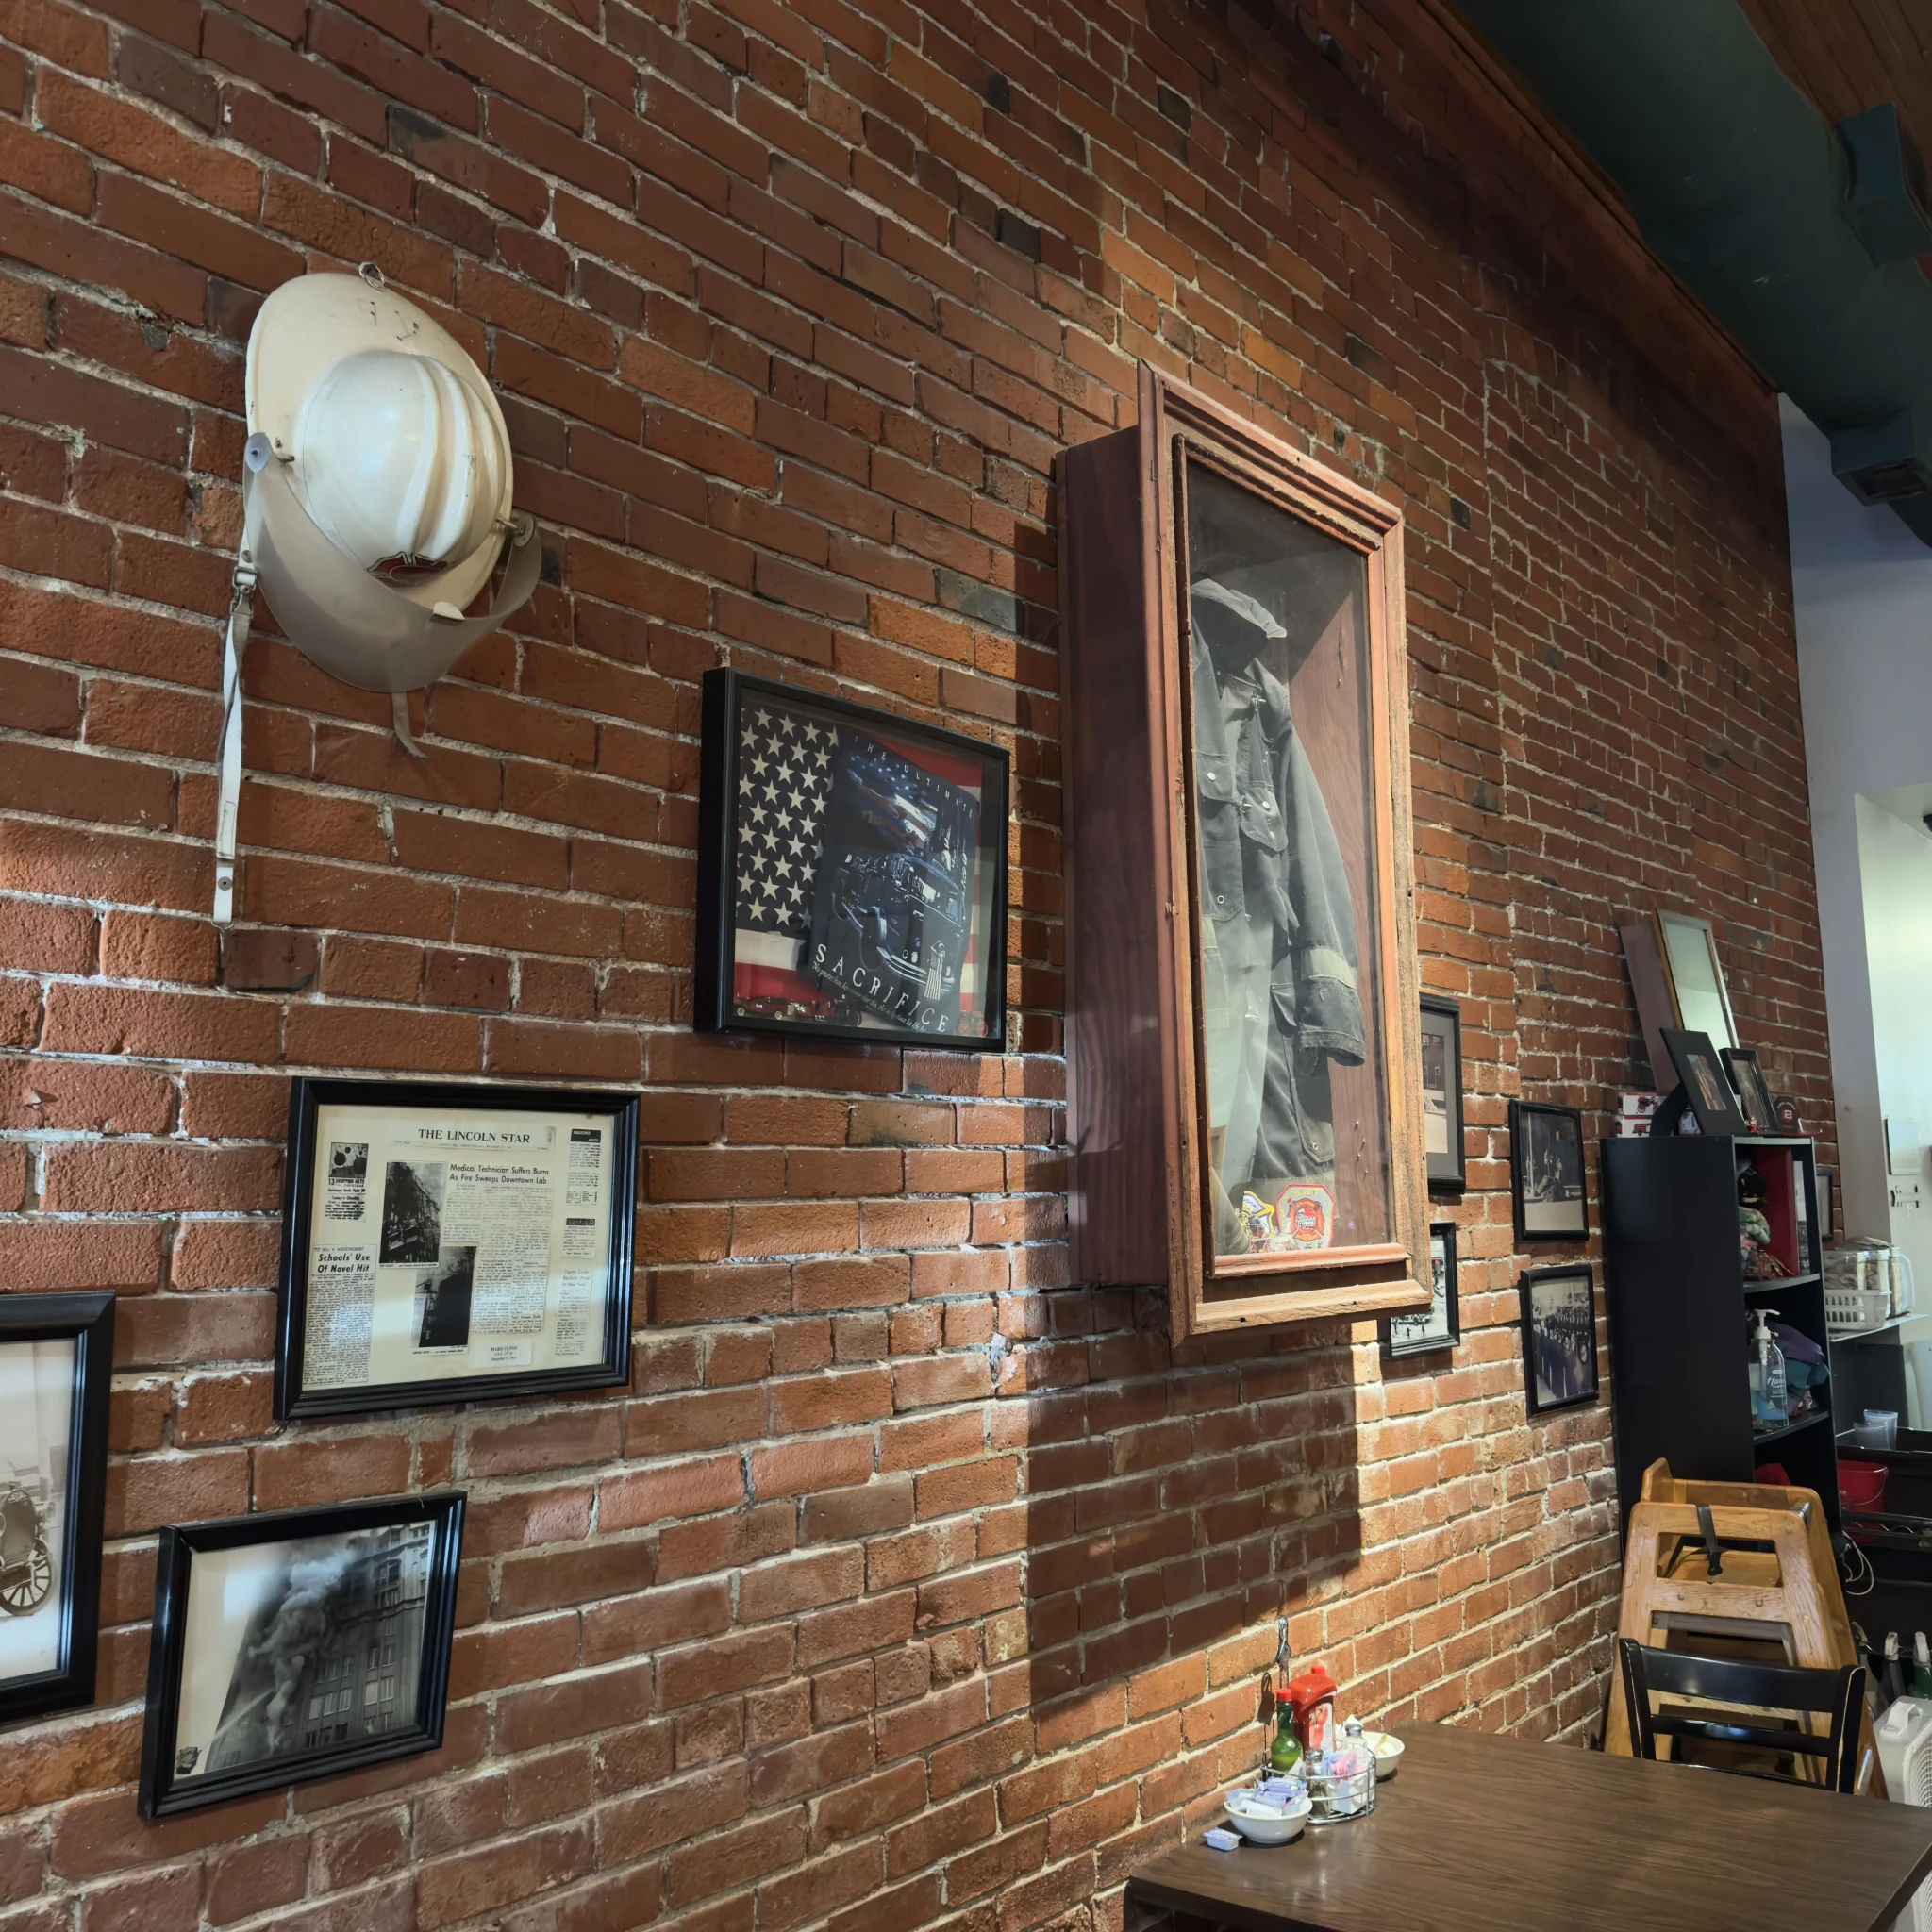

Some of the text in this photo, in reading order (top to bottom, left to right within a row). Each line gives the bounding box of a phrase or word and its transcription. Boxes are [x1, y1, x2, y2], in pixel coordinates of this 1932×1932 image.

[855, 736, 974, 818] THE ULTIMATE
[815, 943, 949, 1033] SACRIFICE
[419, 1128, 530, 1143] THE LINCOLN STAR
[450, 1164, 476, 1173] Medical
[478, 1165, 509, 1174] Technician
[511, 1166, 531, 1174] Suffers
[460, 1174, 473, 1182] Fire
[475, 1174, 499, 1183] Sweeps
[501, 1175, 534, 1184] Downtown
[318, 1253, 371, 1262] Schools' Use
[317, 1264, 328, 1273] Of
[330, 1264, 354, 1273] Novel
